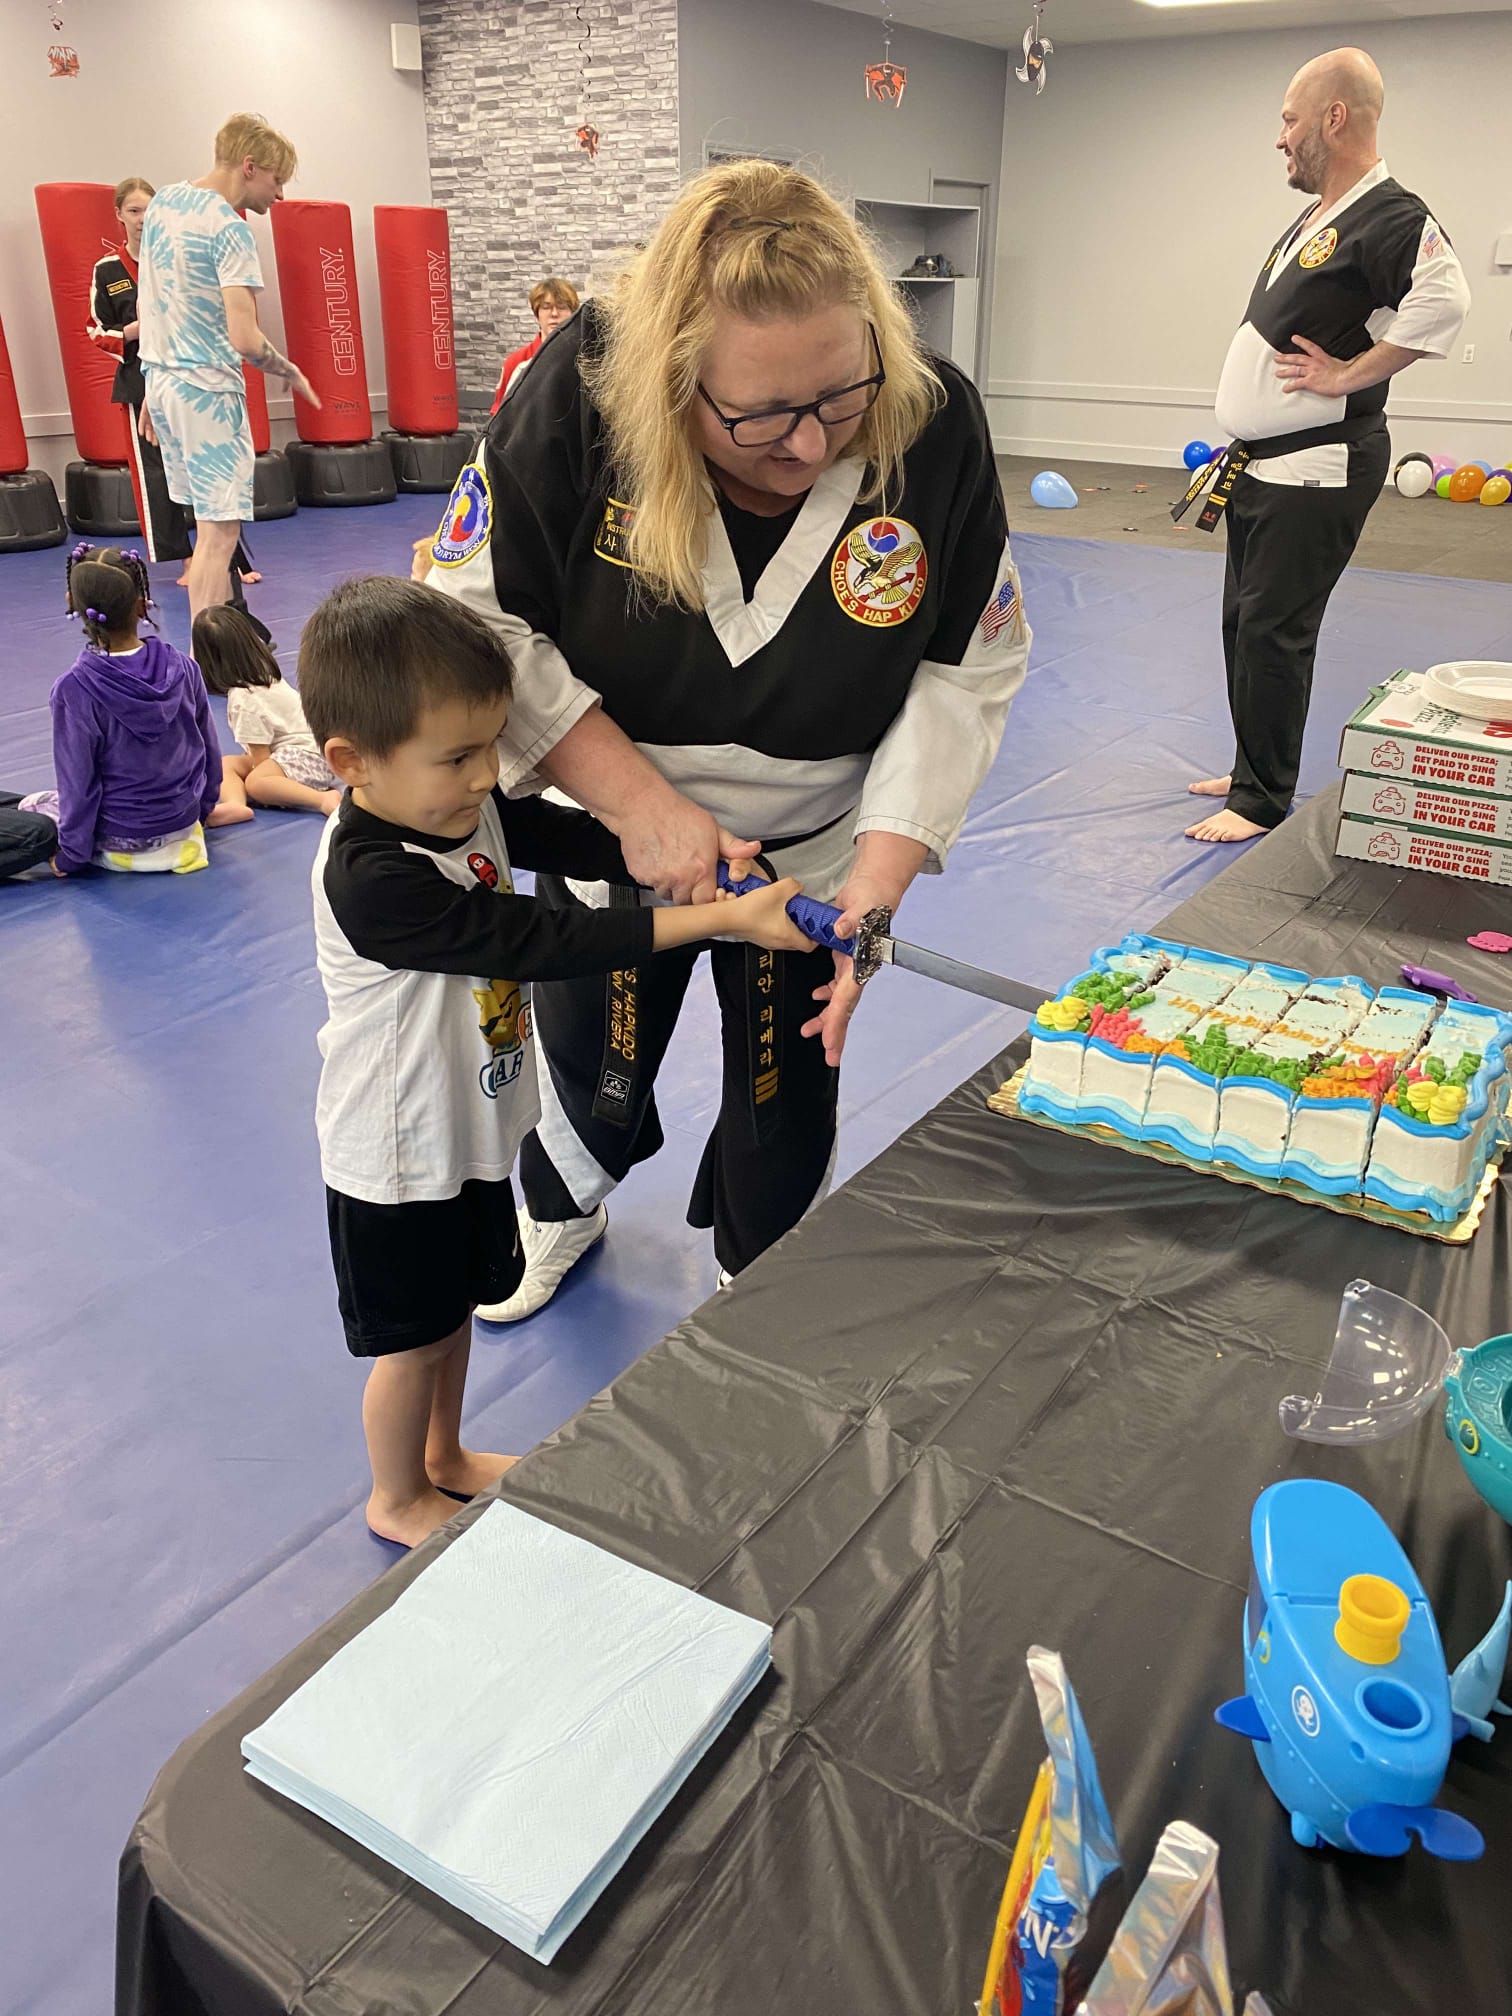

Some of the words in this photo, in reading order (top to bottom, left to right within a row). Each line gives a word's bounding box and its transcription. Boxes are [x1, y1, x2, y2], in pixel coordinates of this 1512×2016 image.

[835, 560, 859, 611] CHOE'S
[863, 608, 892, 622] HAP
[899, 602, 913, 617] KI
[913, 577, 925, 599] DO
[1416, 746, 1449, 757] DELIVER
[1451, 752, 1469, 760] OUR
[1414, 755, 1431, 764] GET
[1433, 758, 1455, 768] PAID
[1458, 762, 1469, 770] TO
[1472, 765, 1495, 774] SING
[1412, 765, 1426, 775] IN
[1429, 767, 1465, 781] YOUR
[1468, 774, 1495, 786] CAR
[1417, 792, 1451, 803] DELIVER
[1452, 798, 1470, 807] OUR
[1413, 810, 1427, 820] IN
[1430, 813, 1465, 827] YOUR
[1469, 820, 1496, 832] CAR
[1415, 801, 1432, 810] GET
[1434, 804, 1456, 814] PAID
[1472, 811, 1495, 821] SING
[1411, 837, 1444, 848] DELIVER
[1446, 844, 1465, 852] OUR
[1408, 855, 1422, 865] IN
[1425, 858, 1460, 872] YOUR
[1463, 865, 1490, 877] CAR
[1410, 846, 1428, 854] GET
[1428, 849, 1450, 859] PAID
[1466, 856, 1489, 866] SING
[610, 996, 622, 1050] RIVERA
[622, 989, 636, 1060] HAPKIDO
